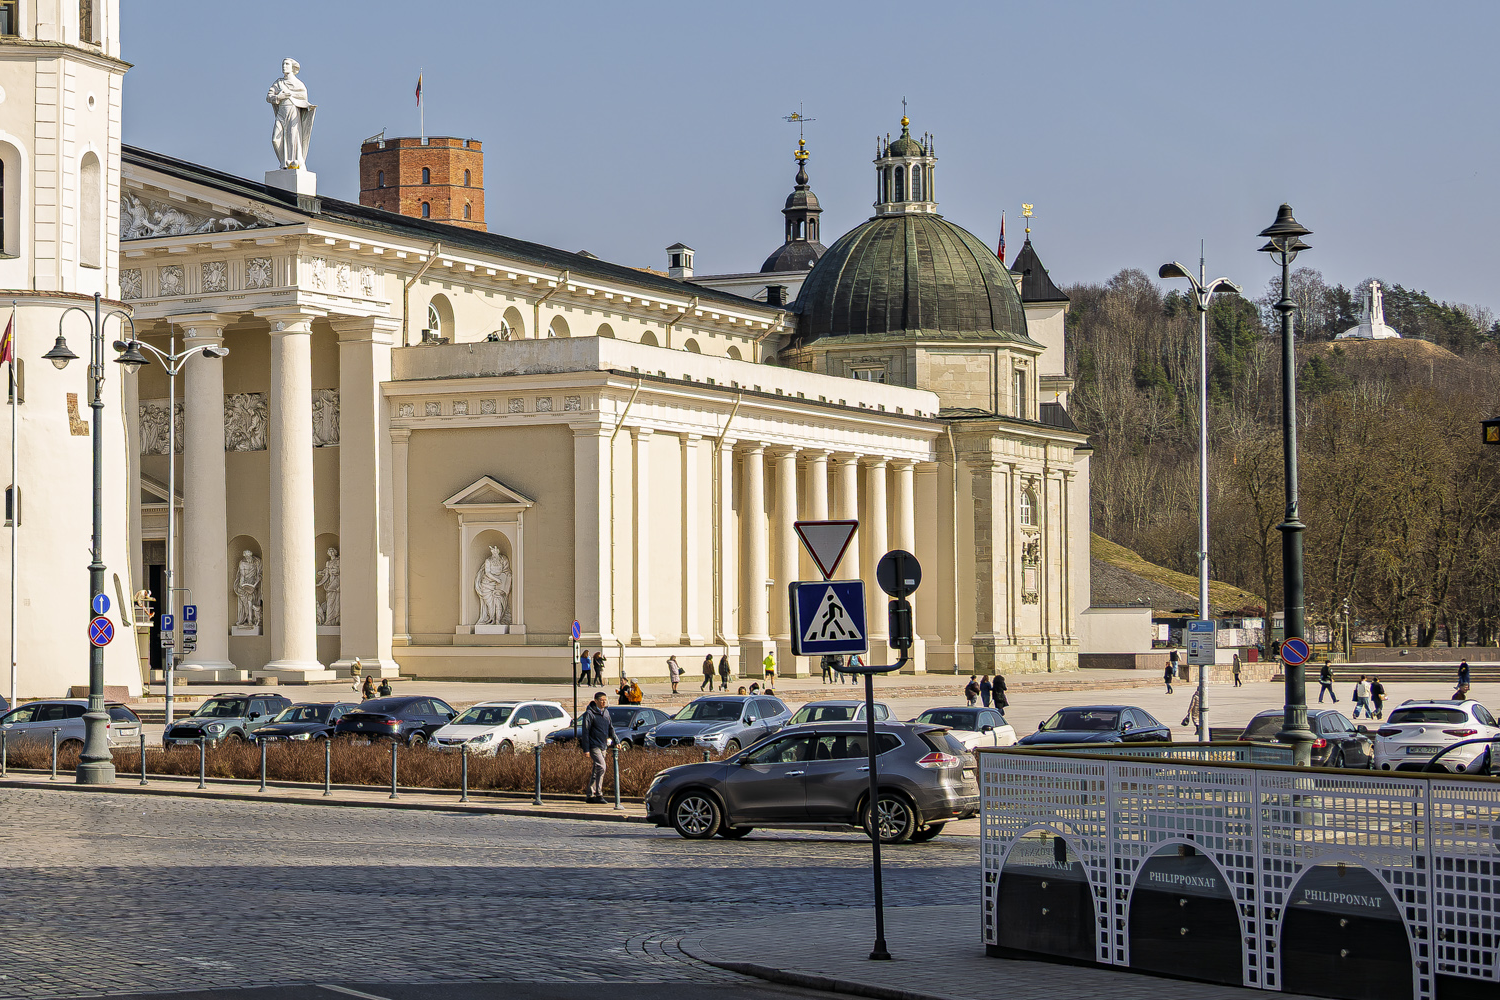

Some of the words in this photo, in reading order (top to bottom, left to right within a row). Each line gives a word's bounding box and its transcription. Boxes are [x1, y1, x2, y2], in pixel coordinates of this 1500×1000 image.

[187, 607, 194, 619] P
[165, 617, 171, 629] P
[1150, 872, 1215, 887] PHILIPPONNAT
[1304, 889, 1381, 907] PHILIPPONNAT
